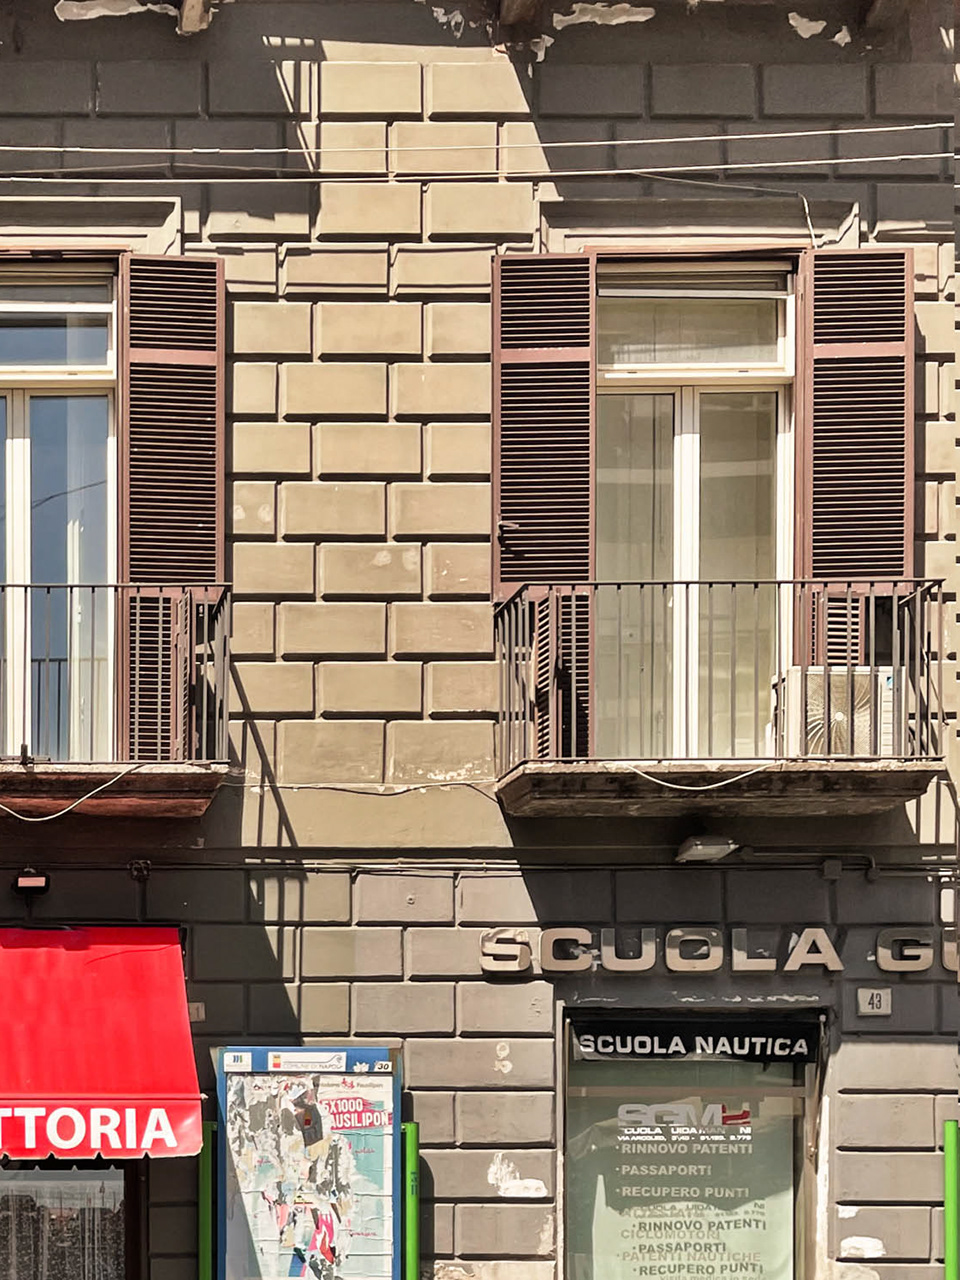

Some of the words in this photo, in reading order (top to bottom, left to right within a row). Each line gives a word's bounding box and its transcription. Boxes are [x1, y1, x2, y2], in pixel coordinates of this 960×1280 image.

[479, 927, 844, 972] SCUOLA
[868, 993, 882, 1010] 43
[580, 1034, 687, 1054] SCUOLA
[695, 1036, 809, 1056] NAUTICA
[621, 1143, 688, 1154] RINNOVO
[692, 1143, 753, 1154] PATENTI
[621, 1165, 712, 1176] PASSAPORTI
[622, 1187, 700, 1197] RECUPERO
[705, 1187, 750, 1198] PUNTI
[638, 1220, 703, 1232] RINNOVO
[708, 1218, 767, 1231] PATENTI
[638, 1242, 727, 1254] PASSAPORTI
[687, 1251, 762, 1263] NAUTICHE
[640, 1263, 716, 1276] RECUPERO
[720, 1261, 764, 1275] PUNTI
